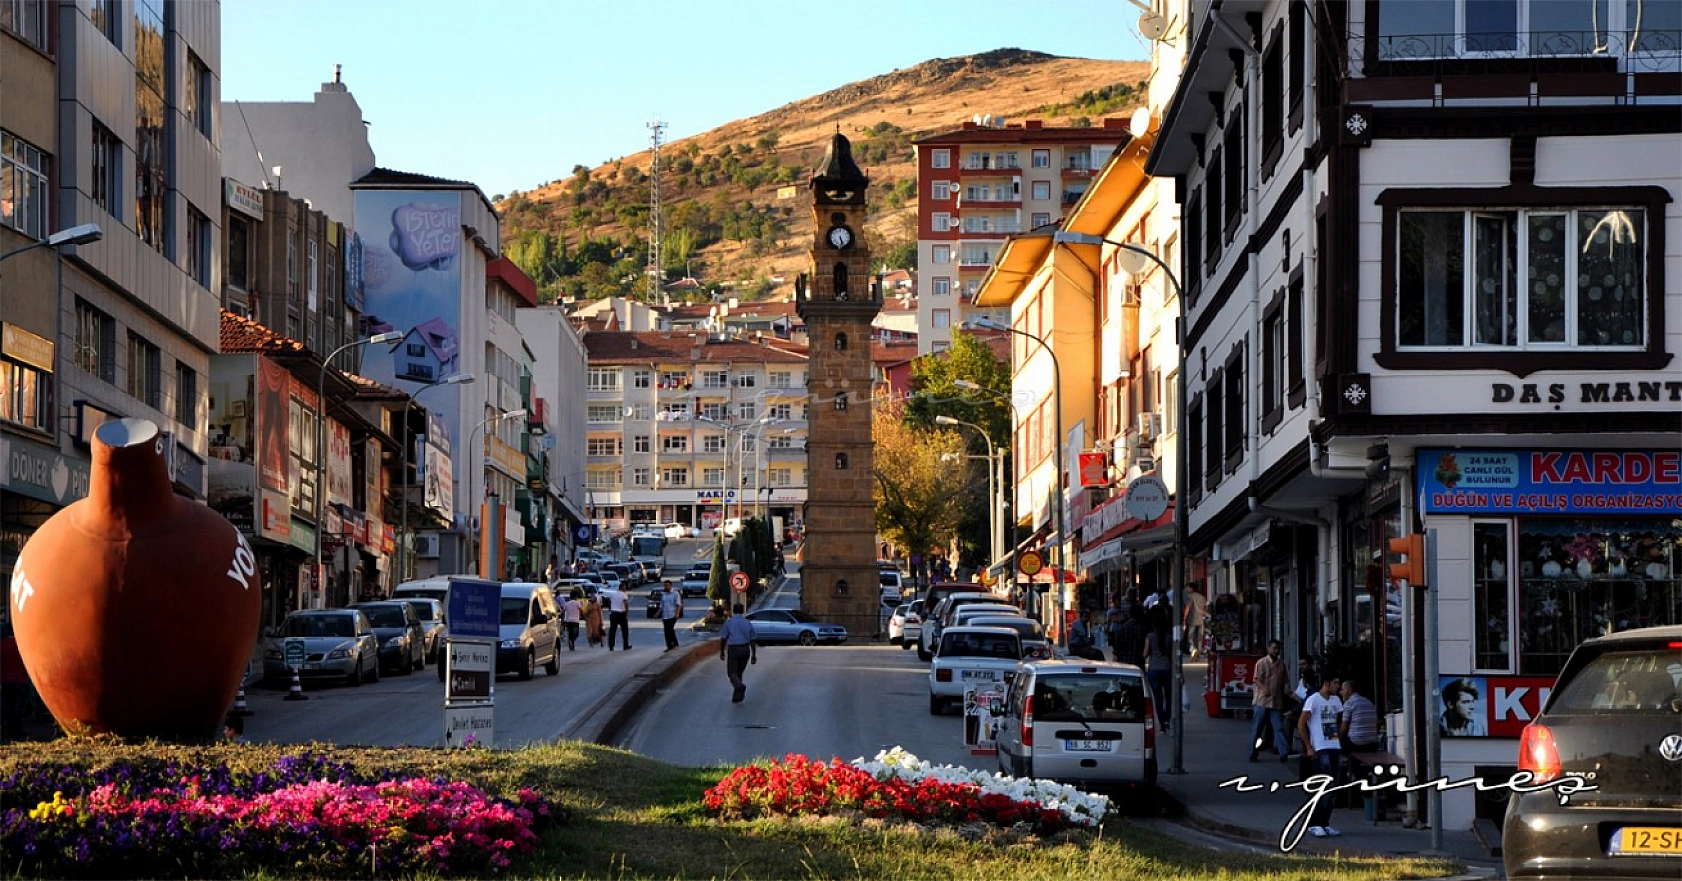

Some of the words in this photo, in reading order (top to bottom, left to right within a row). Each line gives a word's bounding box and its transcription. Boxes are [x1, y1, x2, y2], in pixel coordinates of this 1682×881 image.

[1492, 383, 1565, 411] DAŞ
[1581, 382, 1682, 403] MANT
[1469, 456, 1482, 465] 24
[1483, 456, 1508, 465] SAAT
[12, 448, 48, 488] DÖNER
[1464, 467, 1493, 475] CANLI
[1494, 465, 1515, 475] GÜL
[1466, 475, 1512, 485] BULUNUR
[697, 491, 735, 499] MAKO
[1433, 491, 1488, 508] DÜĞÜN
[1492, 493, 1512, 507] VE
[1518, 492, 1568, 511] AÇILIŞ
